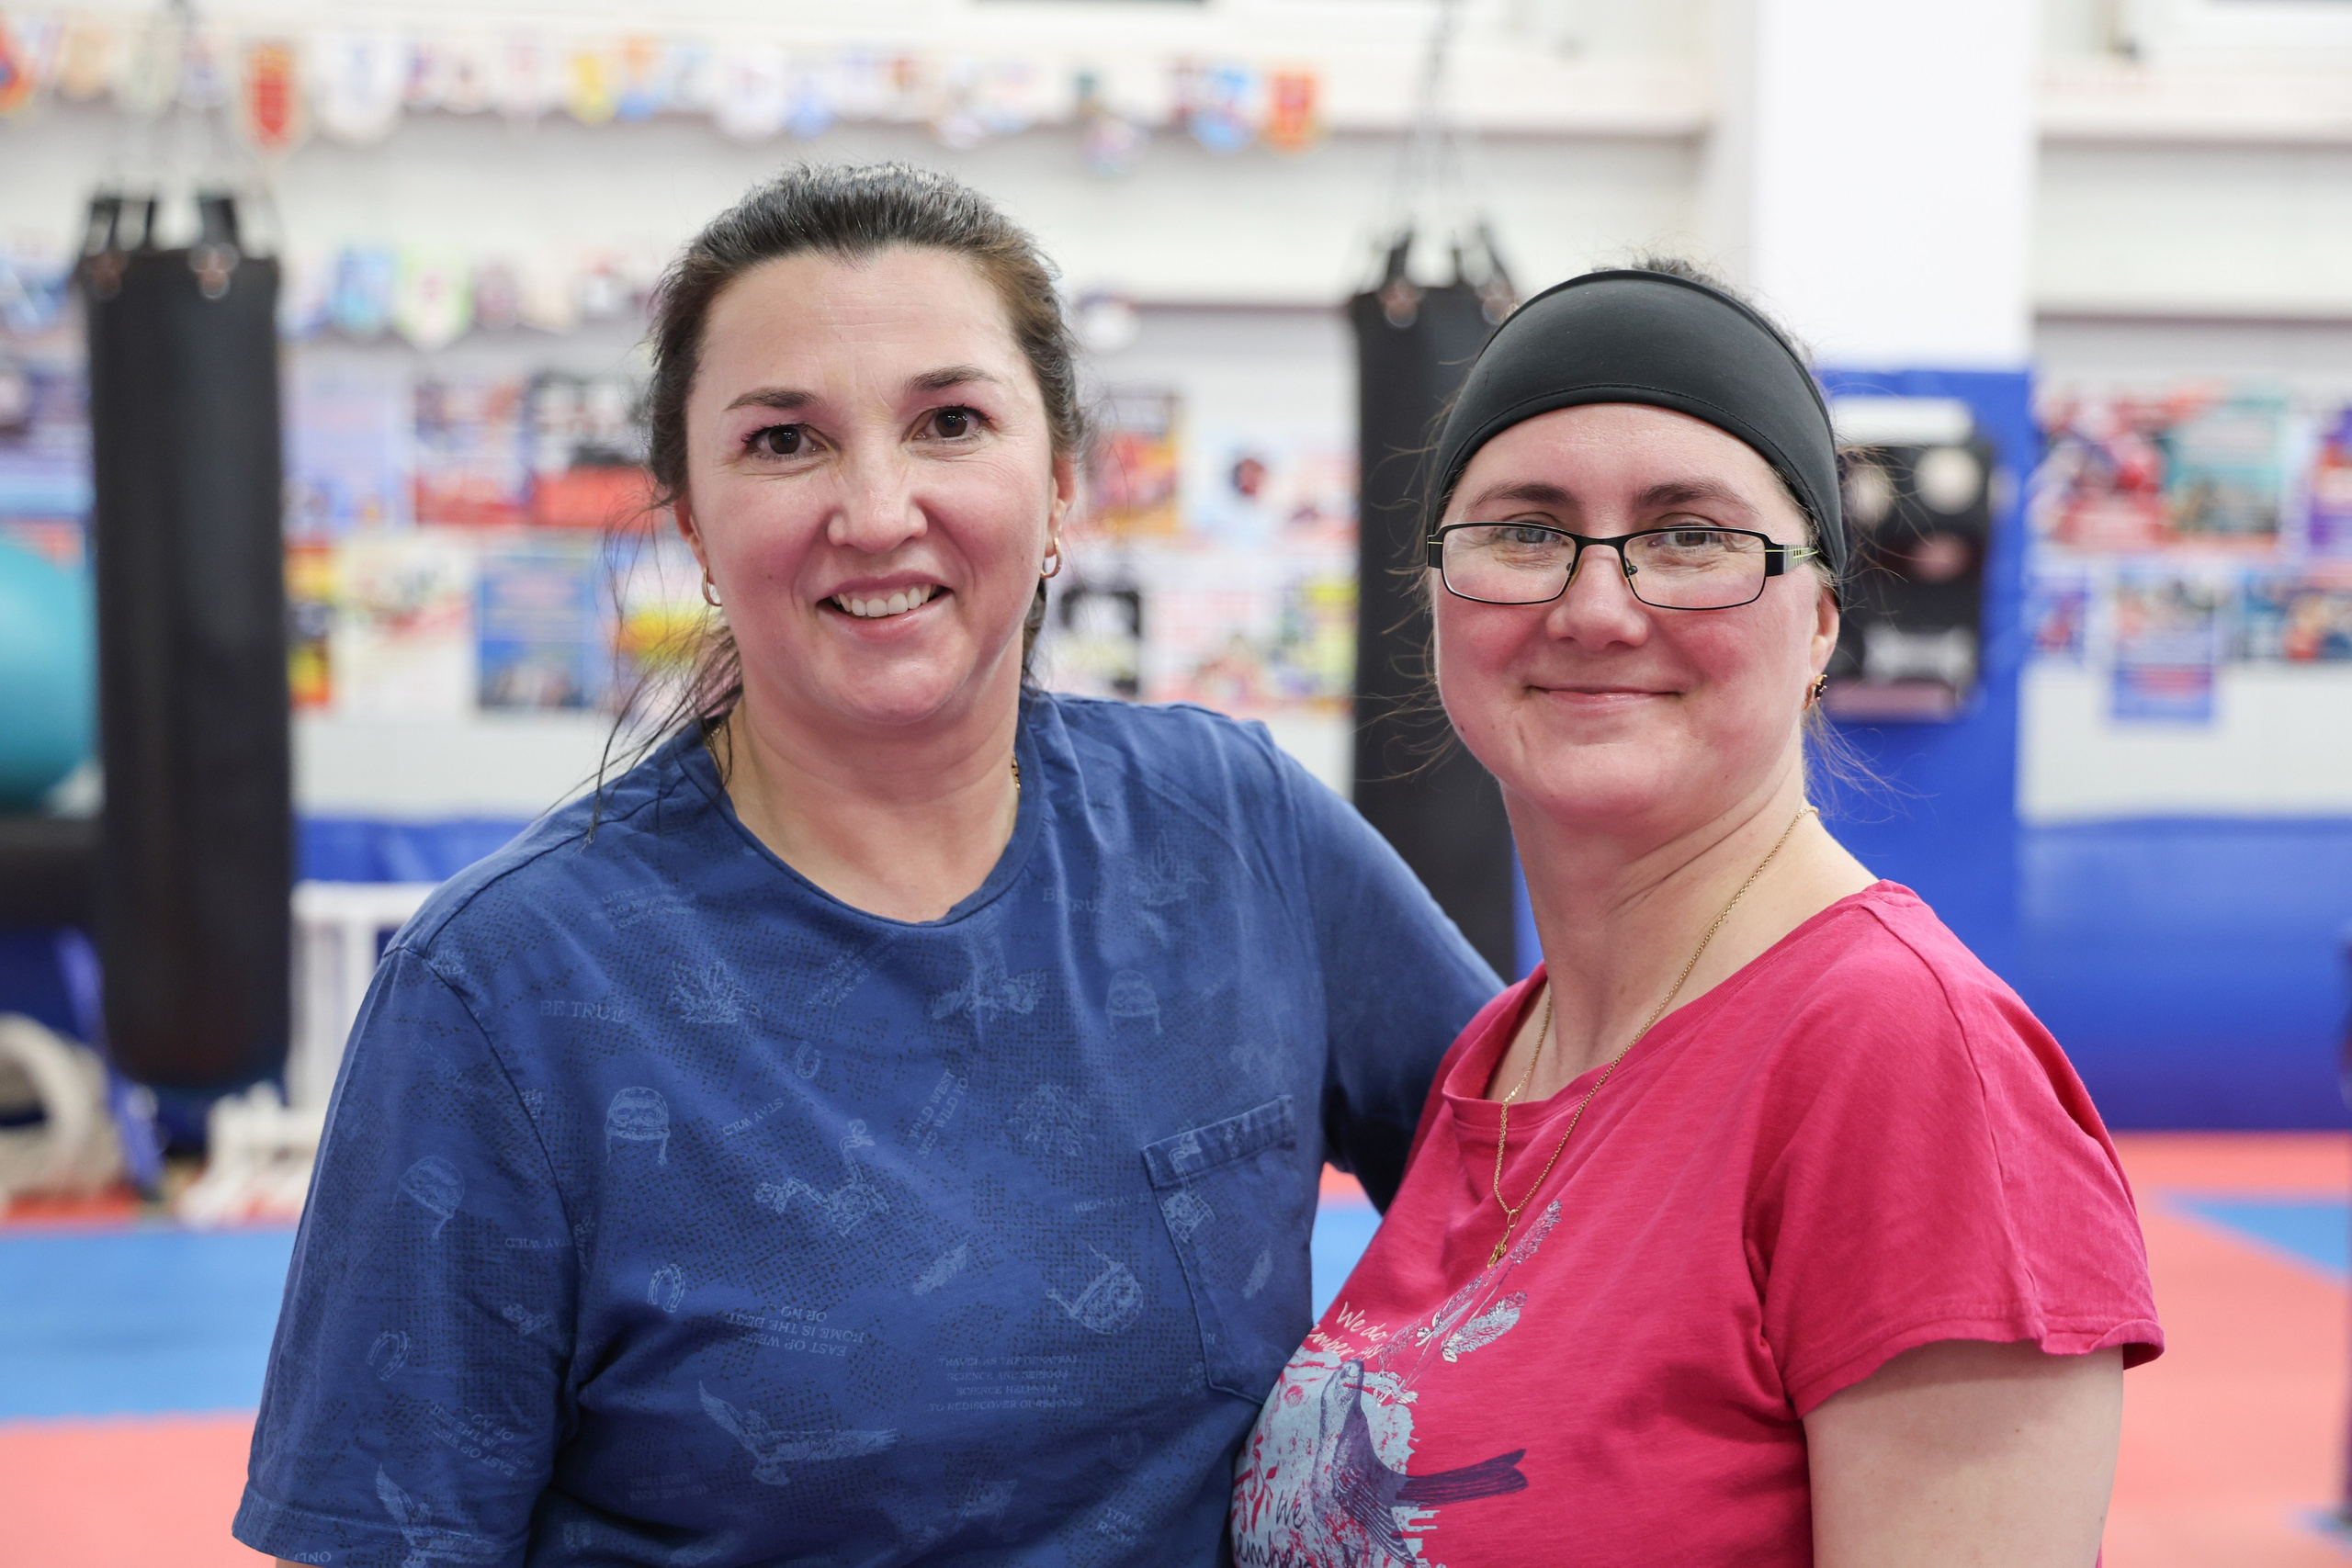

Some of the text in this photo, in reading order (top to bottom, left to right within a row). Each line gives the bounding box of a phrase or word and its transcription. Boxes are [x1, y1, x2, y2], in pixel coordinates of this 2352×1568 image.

[539, 999, 627, 1024] BE TRUE
[929, 1068, 956, 1104] WEST
[754, 1097, 784, 1123] STAY
[934, 1096, 959, 1130] WILD
[768, 1319, 797, 1336] THE
[801, 1325, 817, 1337] IS
[1336, 1301, 1388, 1341] We do
[820, 1328, 865, 1344] HOME
[808, 1343, 847, 1357] EAST
[956, 1385, 1002, 1396] SCIENCE
[947, 1399, 1017, 1411] REDISCOVER
[481, 1455, 516, 1477] EAST
[1276, 1489, 1306, 1529] We
